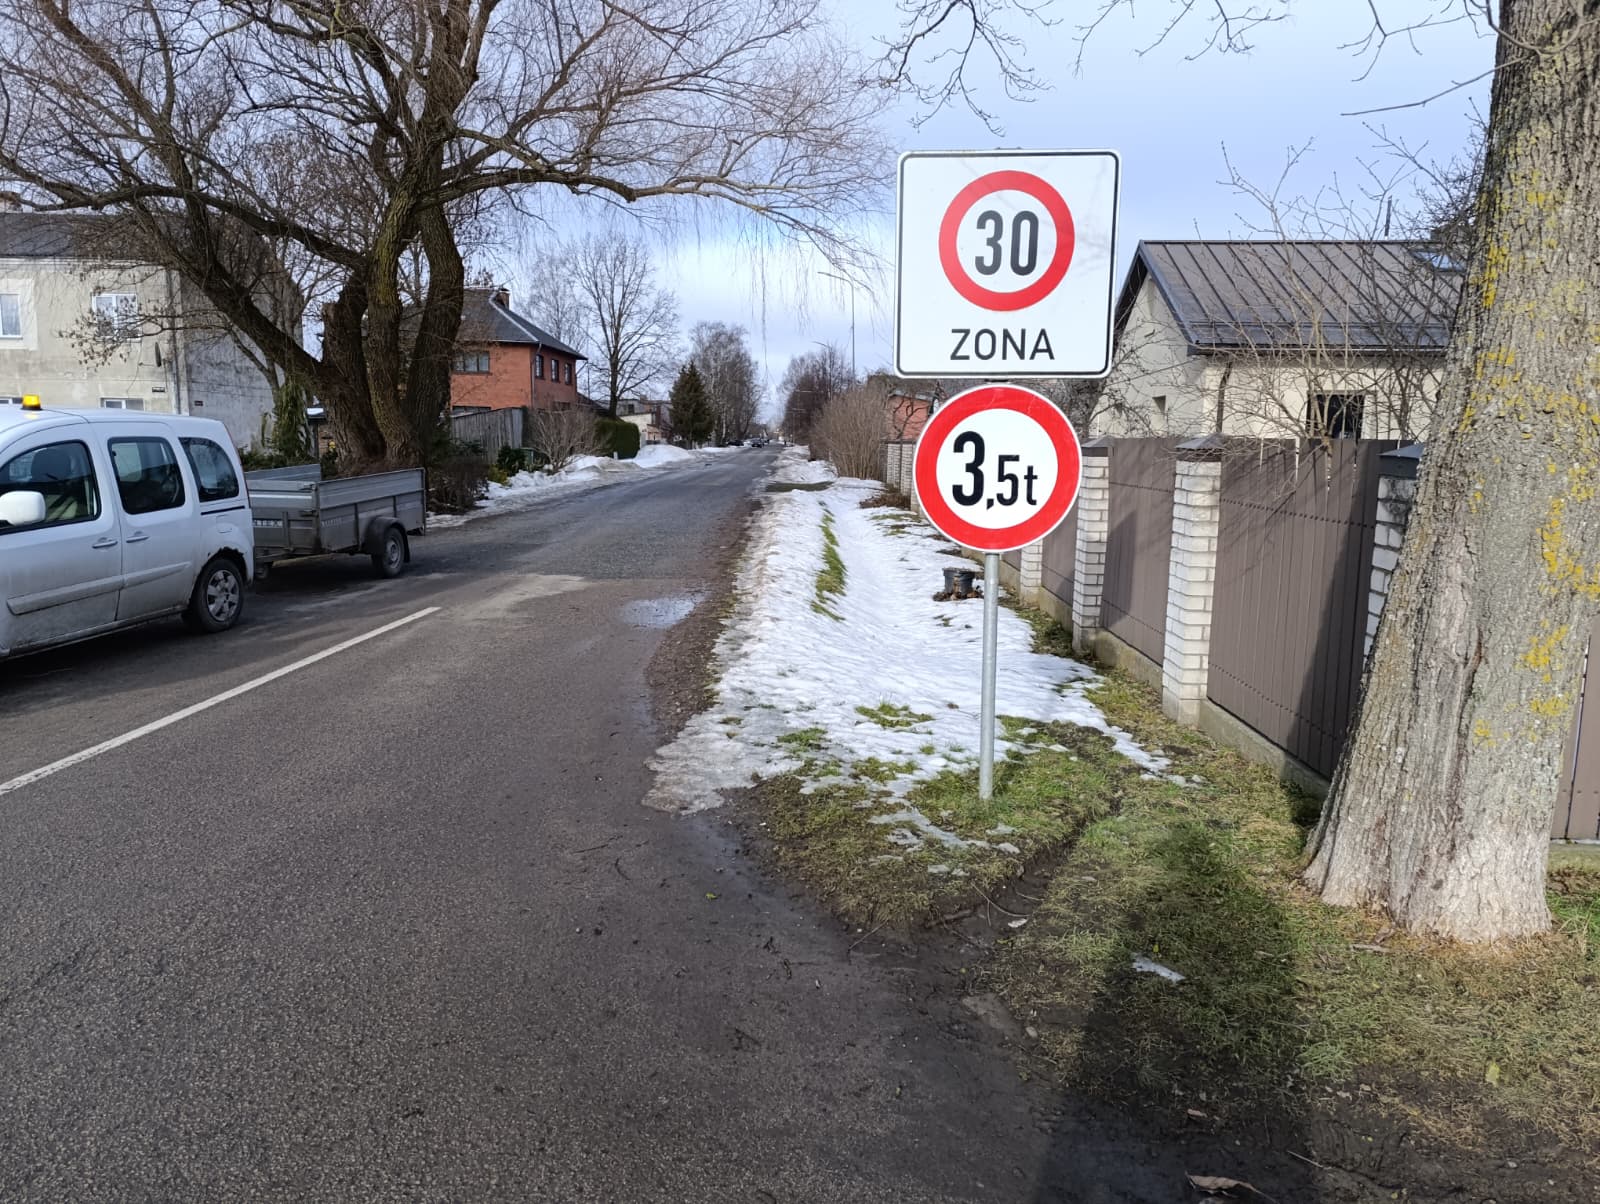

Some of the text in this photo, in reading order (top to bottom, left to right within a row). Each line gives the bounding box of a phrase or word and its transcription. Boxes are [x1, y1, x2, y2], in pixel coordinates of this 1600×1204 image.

[975, 210, 1039, 276] 30
[950, 328, 1055, 361] ZONA
[952, 430, 1038, 510] 3,5t
